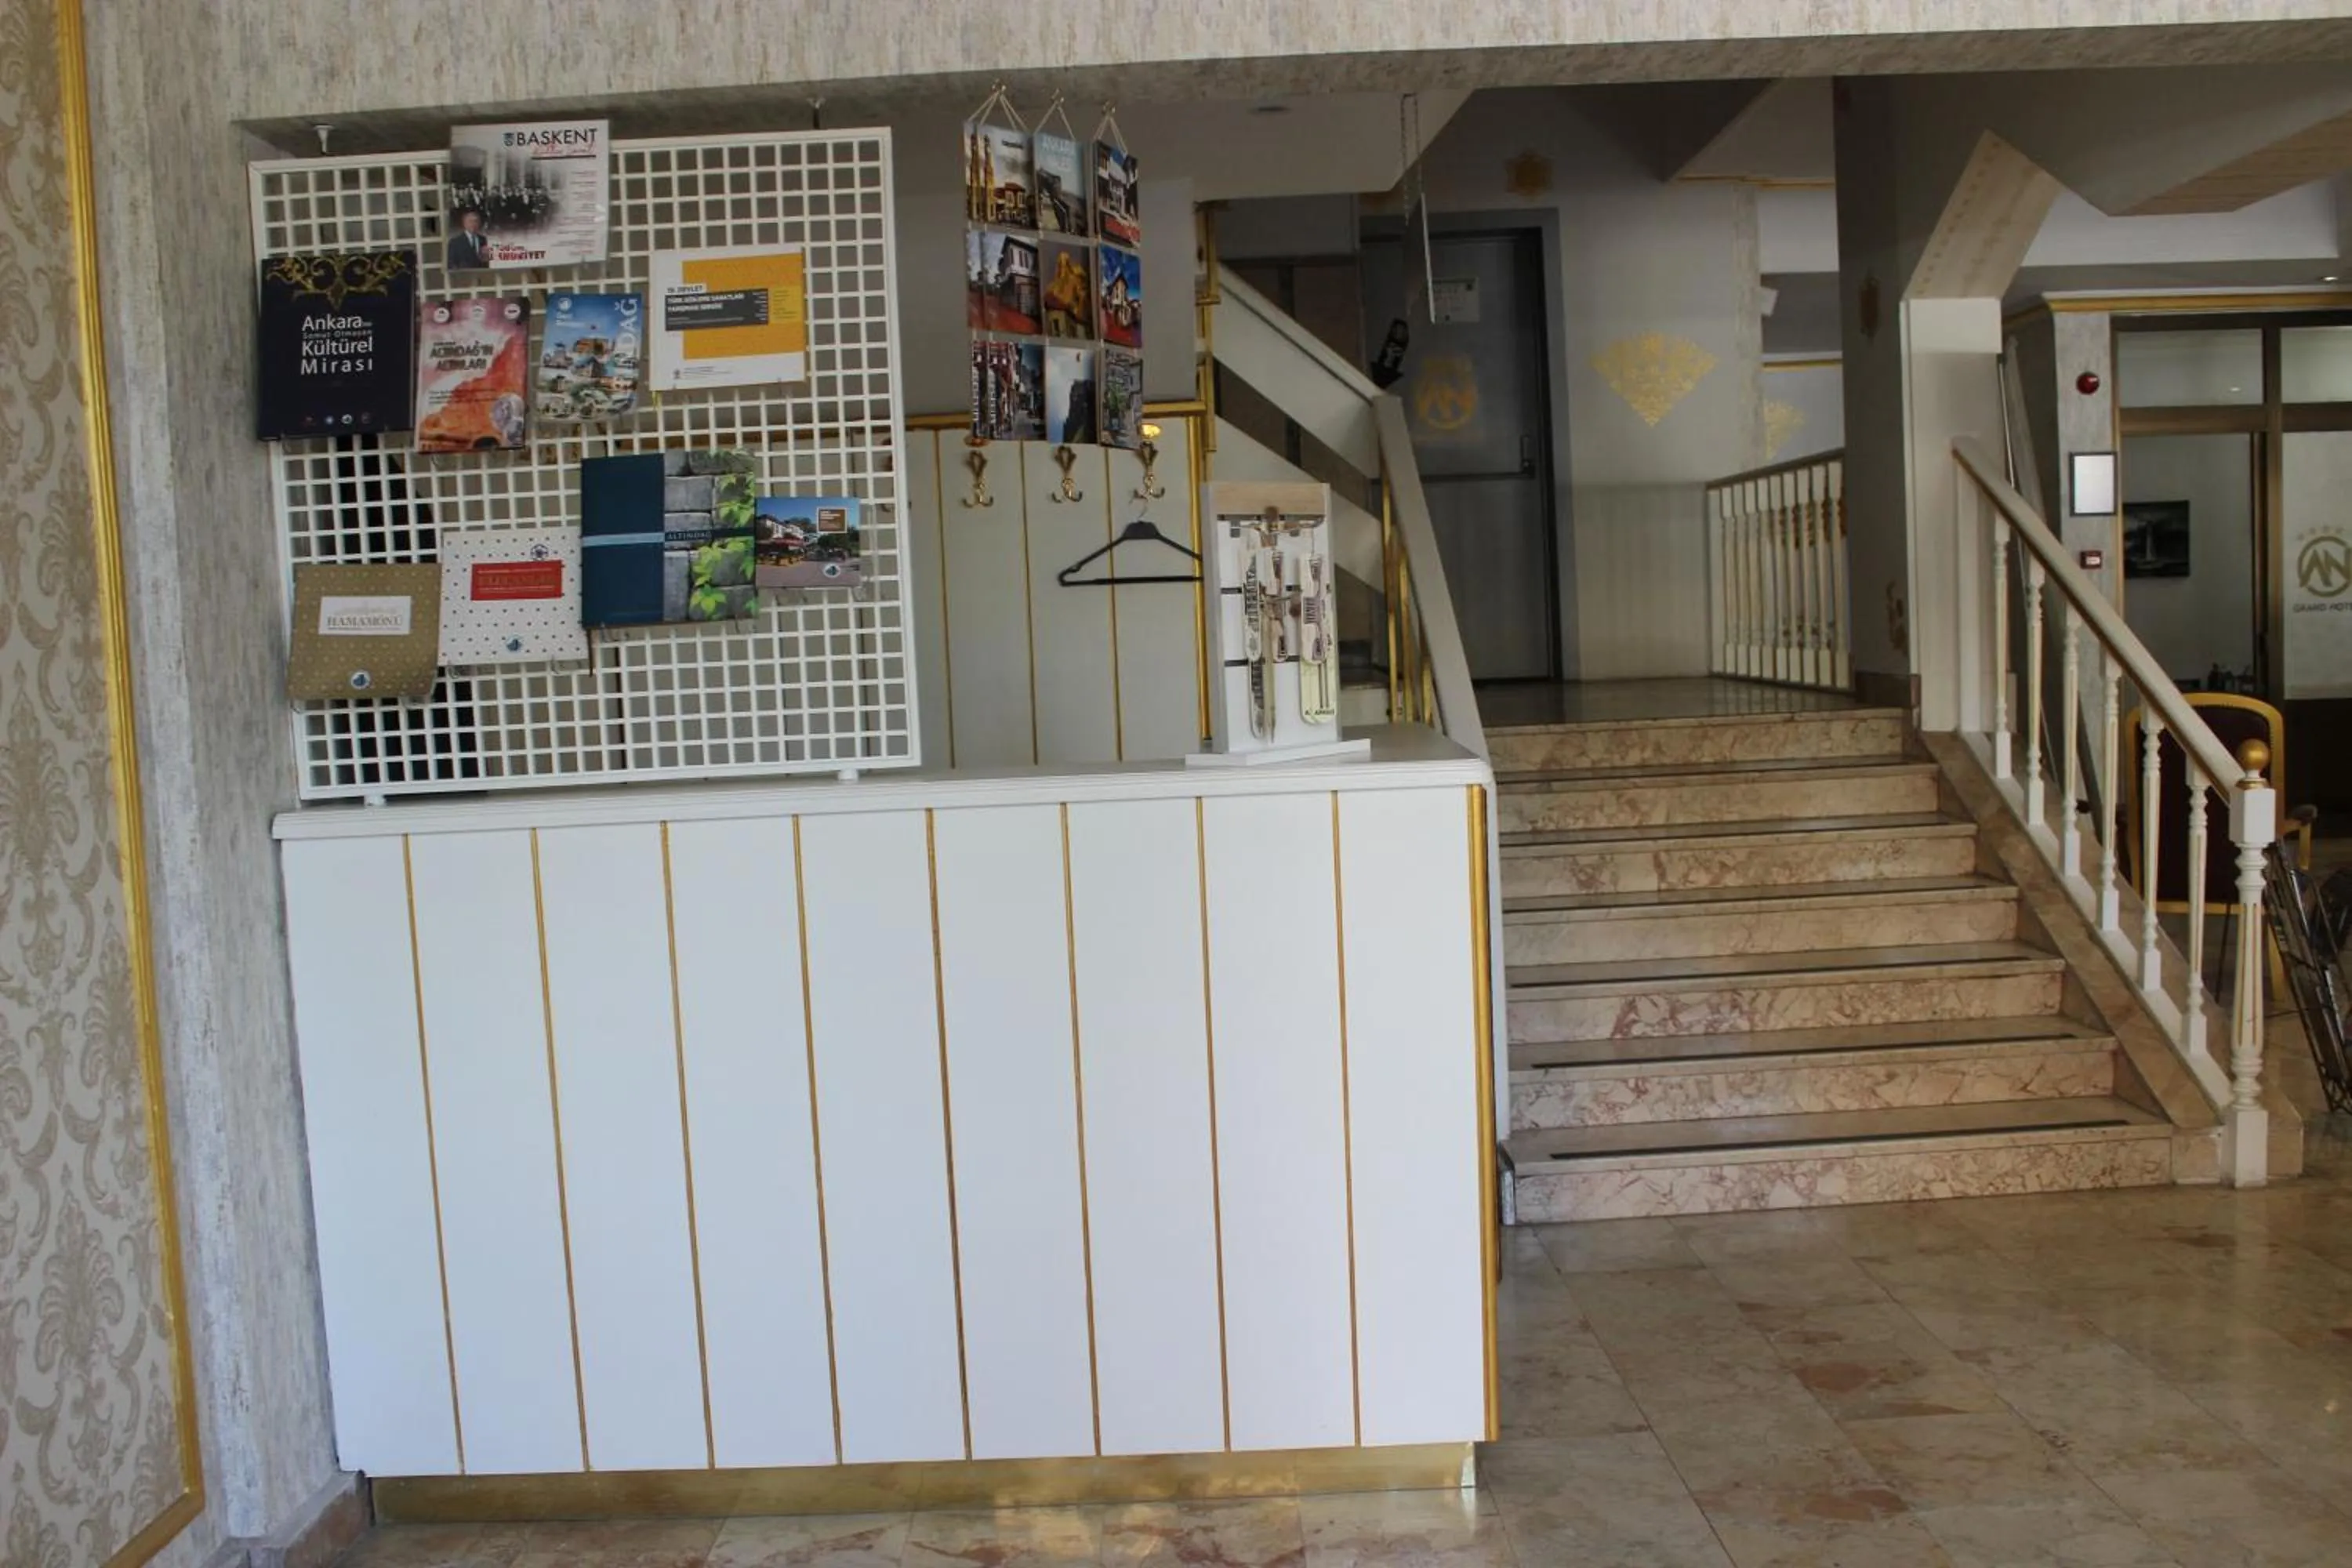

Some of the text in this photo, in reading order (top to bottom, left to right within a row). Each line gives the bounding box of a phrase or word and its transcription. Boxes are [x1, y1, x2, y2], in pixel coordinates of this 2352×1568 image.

[301, 314, 362, 331] Ankara
[301, 336, 373, 357] Kültürel
[300, 358, 373, 375] Mirası
